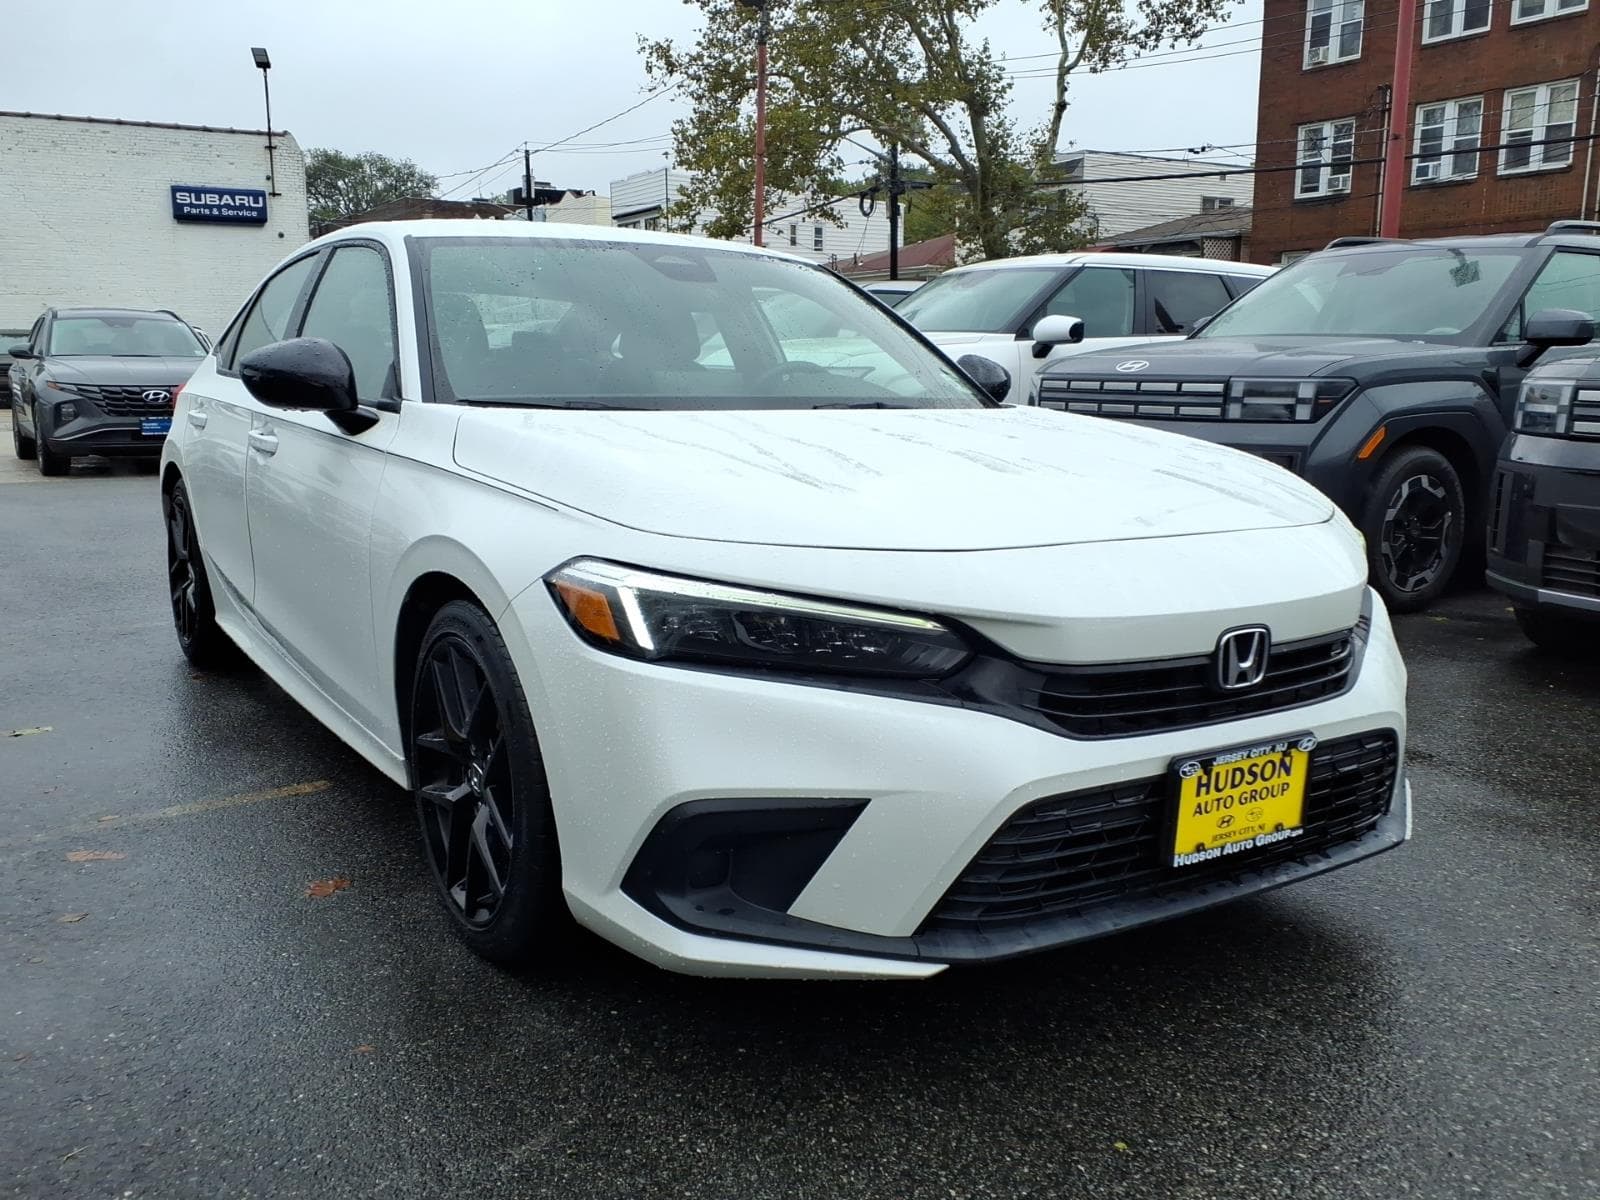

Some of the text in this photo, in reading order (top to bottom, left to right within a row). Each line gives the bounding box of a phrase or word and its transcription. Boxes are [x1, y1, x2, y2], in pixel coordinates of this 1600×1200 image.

[175, 192, 263, 208] SUBARU
[183, 206, 258, 217] Parts & Service
[1213, 751, 1250, 765] JERSEY
[1275, 741, 1288, 753] NJ
[1195, 756, 1293, 797] HUDSON
[1192, 782, 1290, 817] AUTO GROUP
